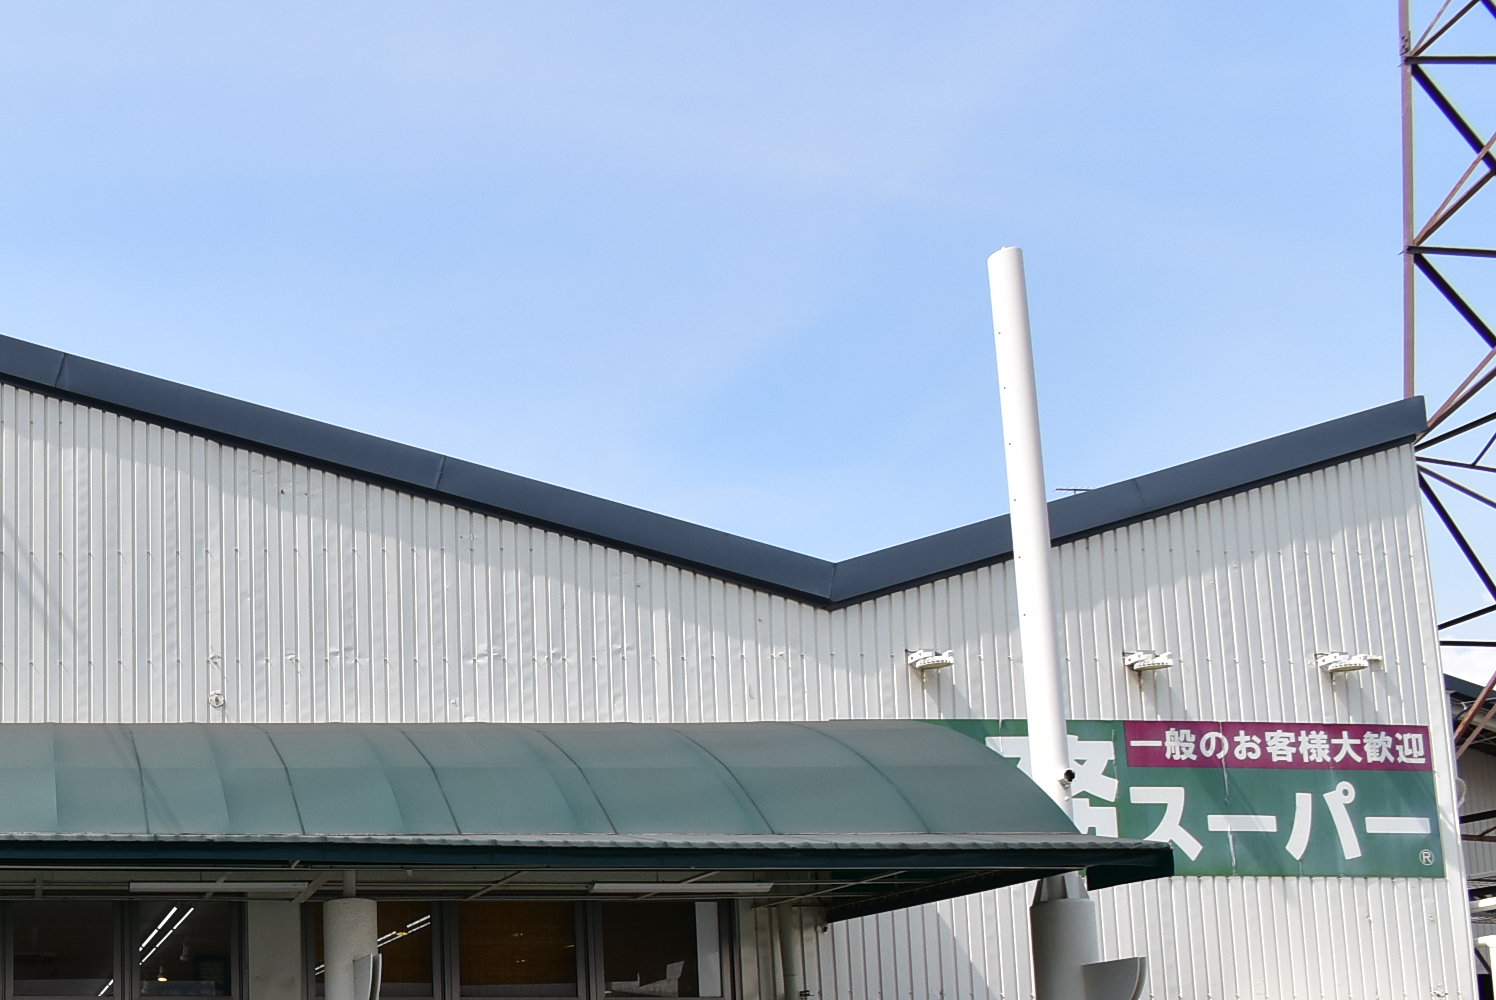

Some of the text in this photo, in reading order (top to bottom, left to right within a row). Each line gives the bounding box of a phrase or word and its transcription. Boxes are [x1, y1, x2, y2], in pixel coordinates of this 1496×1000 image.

[1129, 727, 1427, 764] 一般のお客様大歓迎
